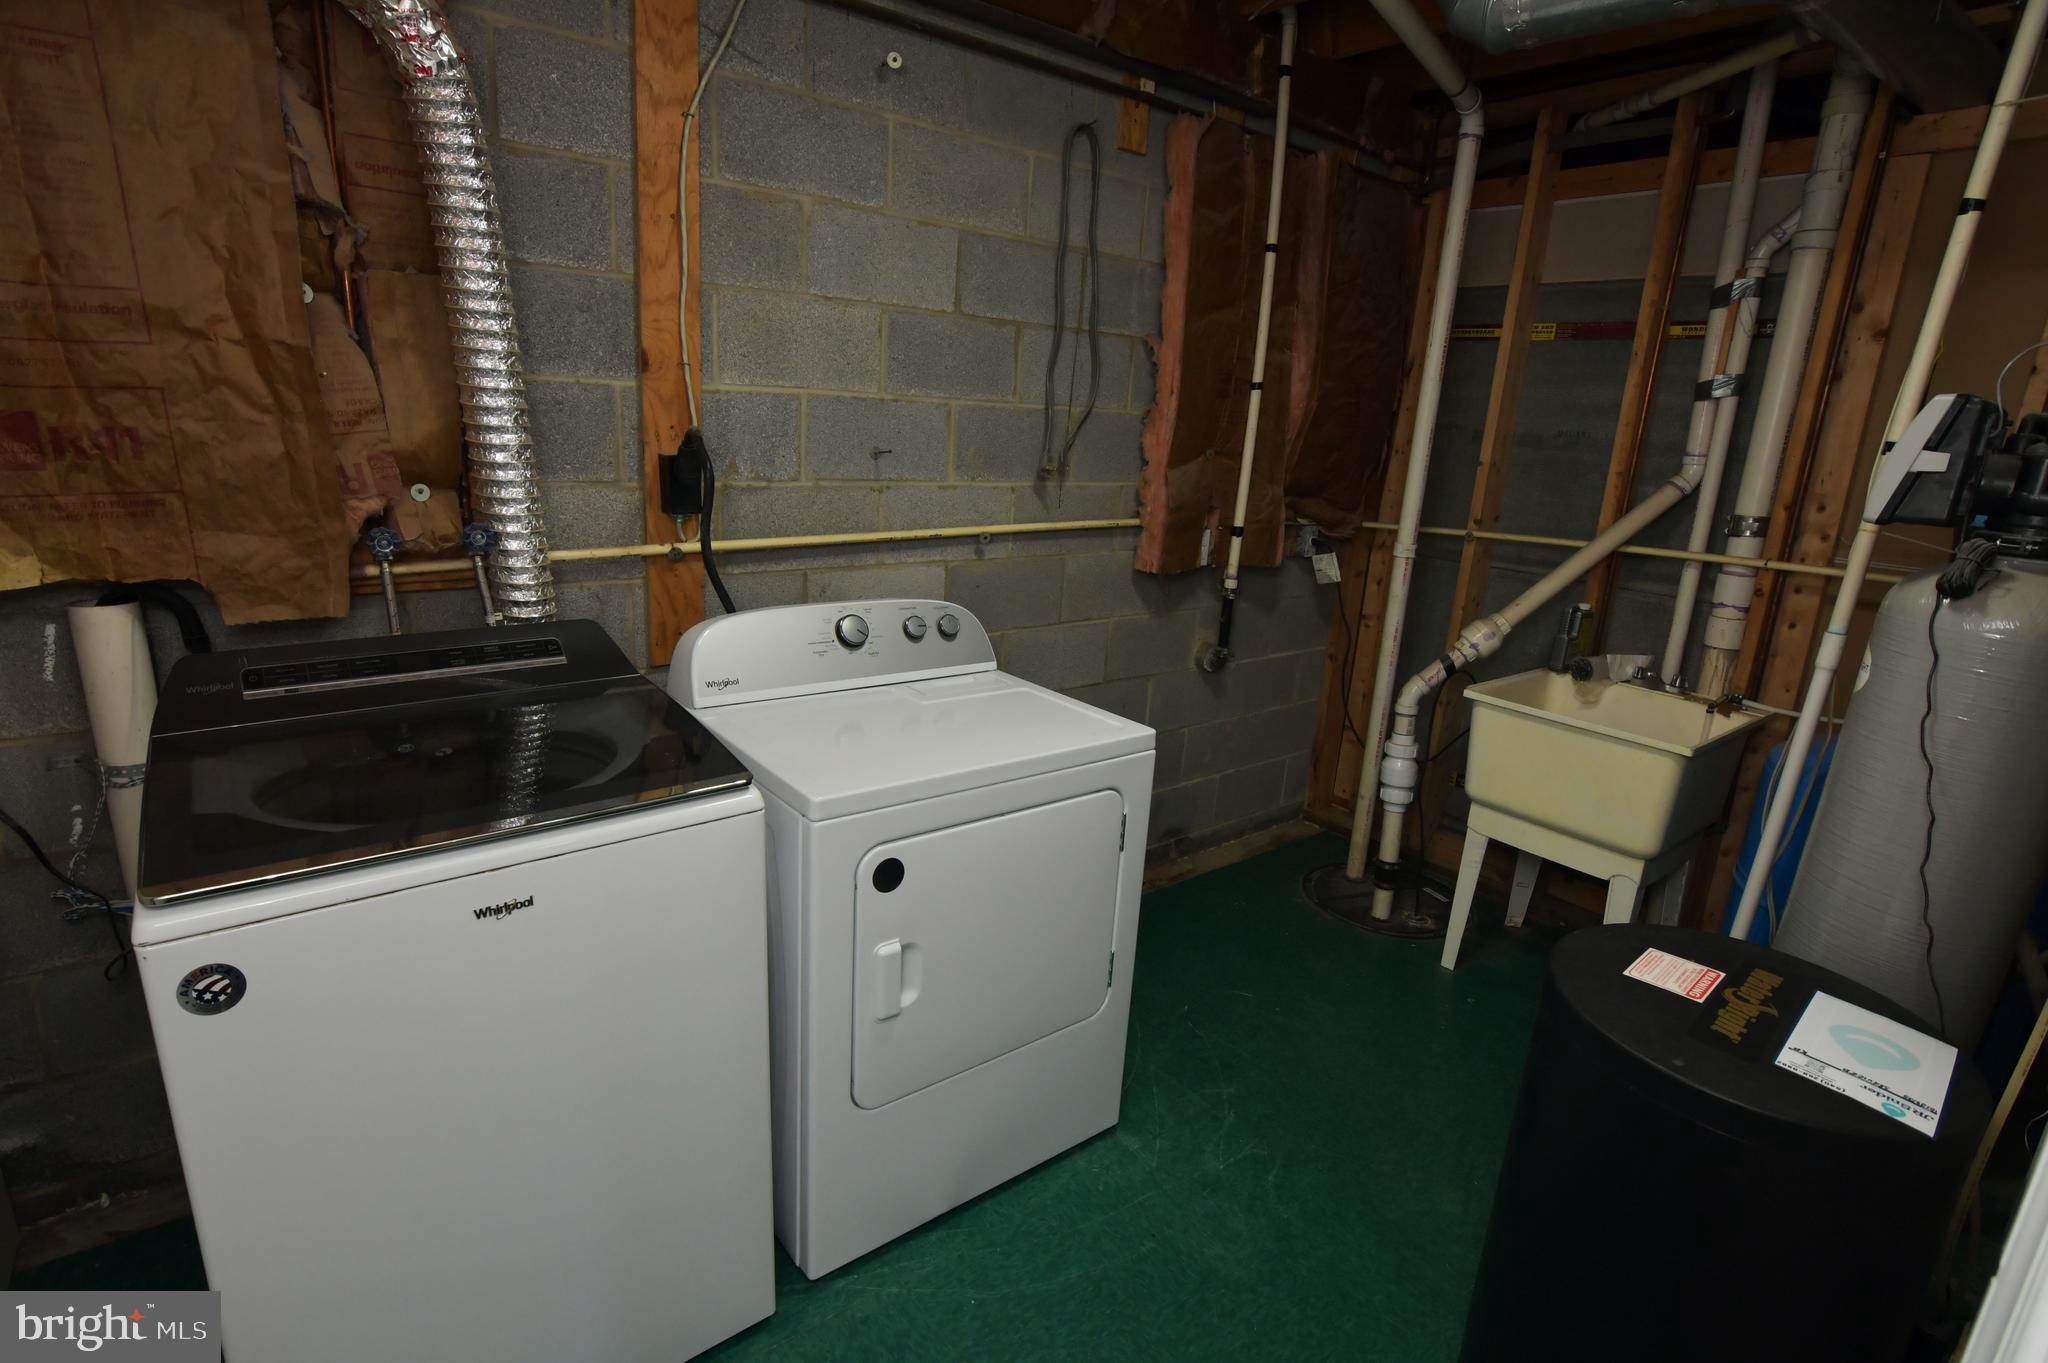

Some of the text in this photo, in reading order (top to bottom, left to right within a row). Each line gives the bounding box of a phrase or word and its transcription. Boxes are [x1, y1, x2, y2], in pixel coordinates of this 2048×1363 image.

[184, 681, 234, 695] Whirlpool
[704, 677, 740, 691] Whirlpool
[473, 895, 534, 920] Whirlpool
